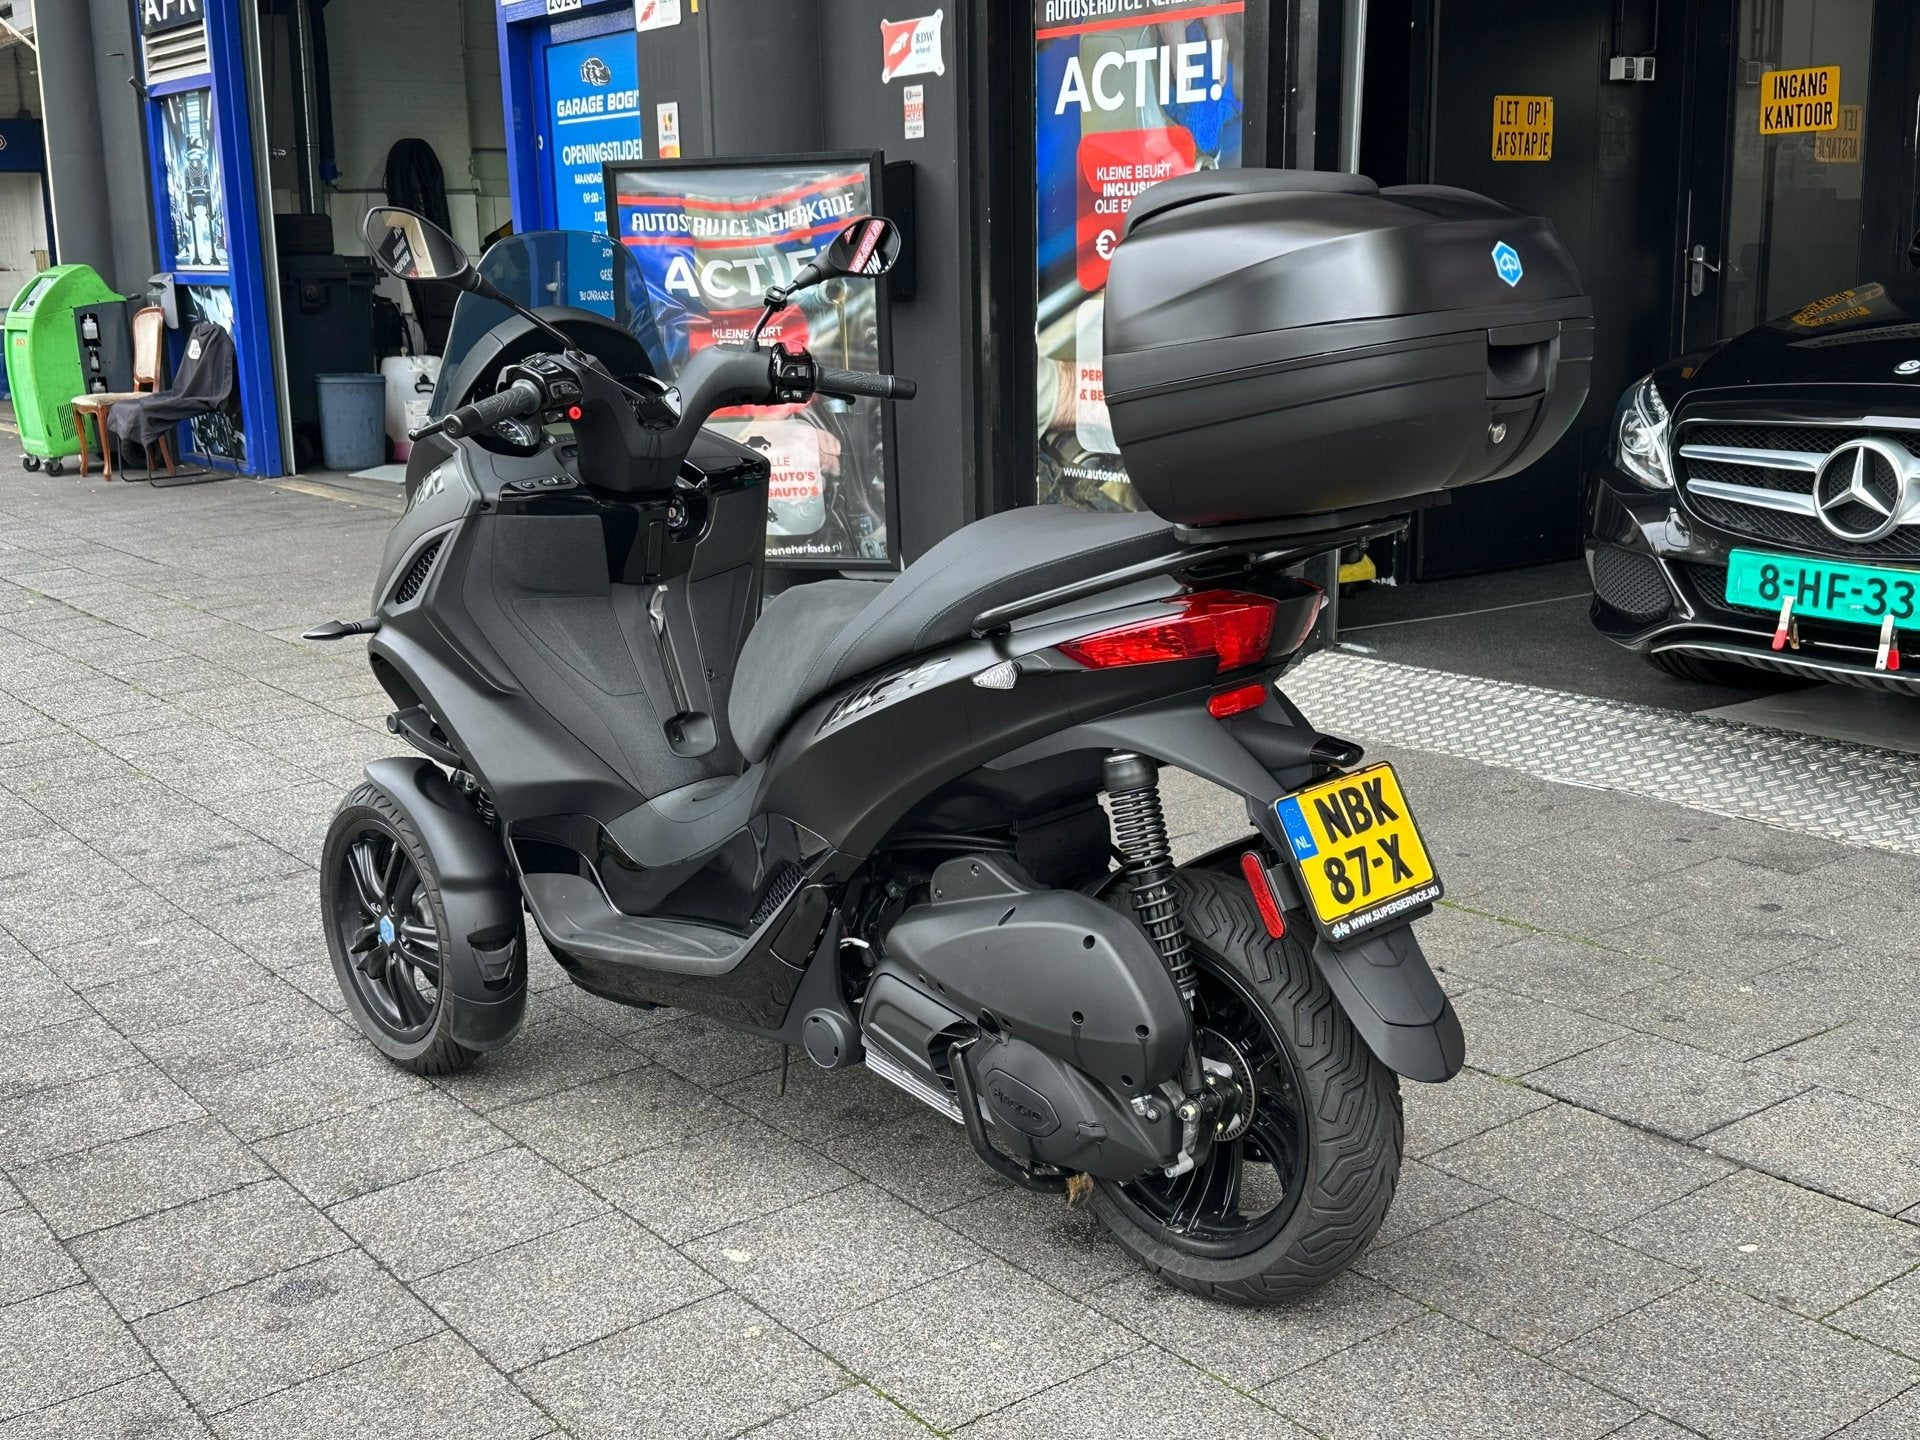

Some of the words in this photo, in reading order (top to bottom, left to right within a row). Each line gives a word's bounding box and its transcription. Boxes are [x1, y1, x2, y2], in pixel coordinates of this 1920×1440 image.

[915, 30, 934, 44] RDW
[1054, 38, 1224, 115] ACTIE!
[1773, 71, 1828, 100] INGANG
[557, 94, 604, 117] GARAGE
[607, 89, 640, 111] BOGI
[1500, 101, 1520, 126] LET
[1527, 101, 1547, 126] OP!
[1764, 101, 1833, 130] KANTOOR
[1496, 131, 1550, 156] AFSTAPJE
[1096, 165, 1133, 181] KLEINE
[1135, 163, 1172, 179] BEURT
[1103, 180, 1163, 197] INCLUSI
[754, 192, 854, 234] NEHERKADE
[1095, 199, 1119, 214] OLIE
[664, 245, 827, 299] ACTIE
[770, 456, 791, 466] LLE
[1759, 564, 1915, 619] 8-HF-33
[1313, 777, 1400, 844] NBK
[1294, 836, 1312, 850] NL
[1323, 833, 1415, 905] 87-X
[1349, 885, 1440, 930] WWW.SUPERSERVICE.NU
